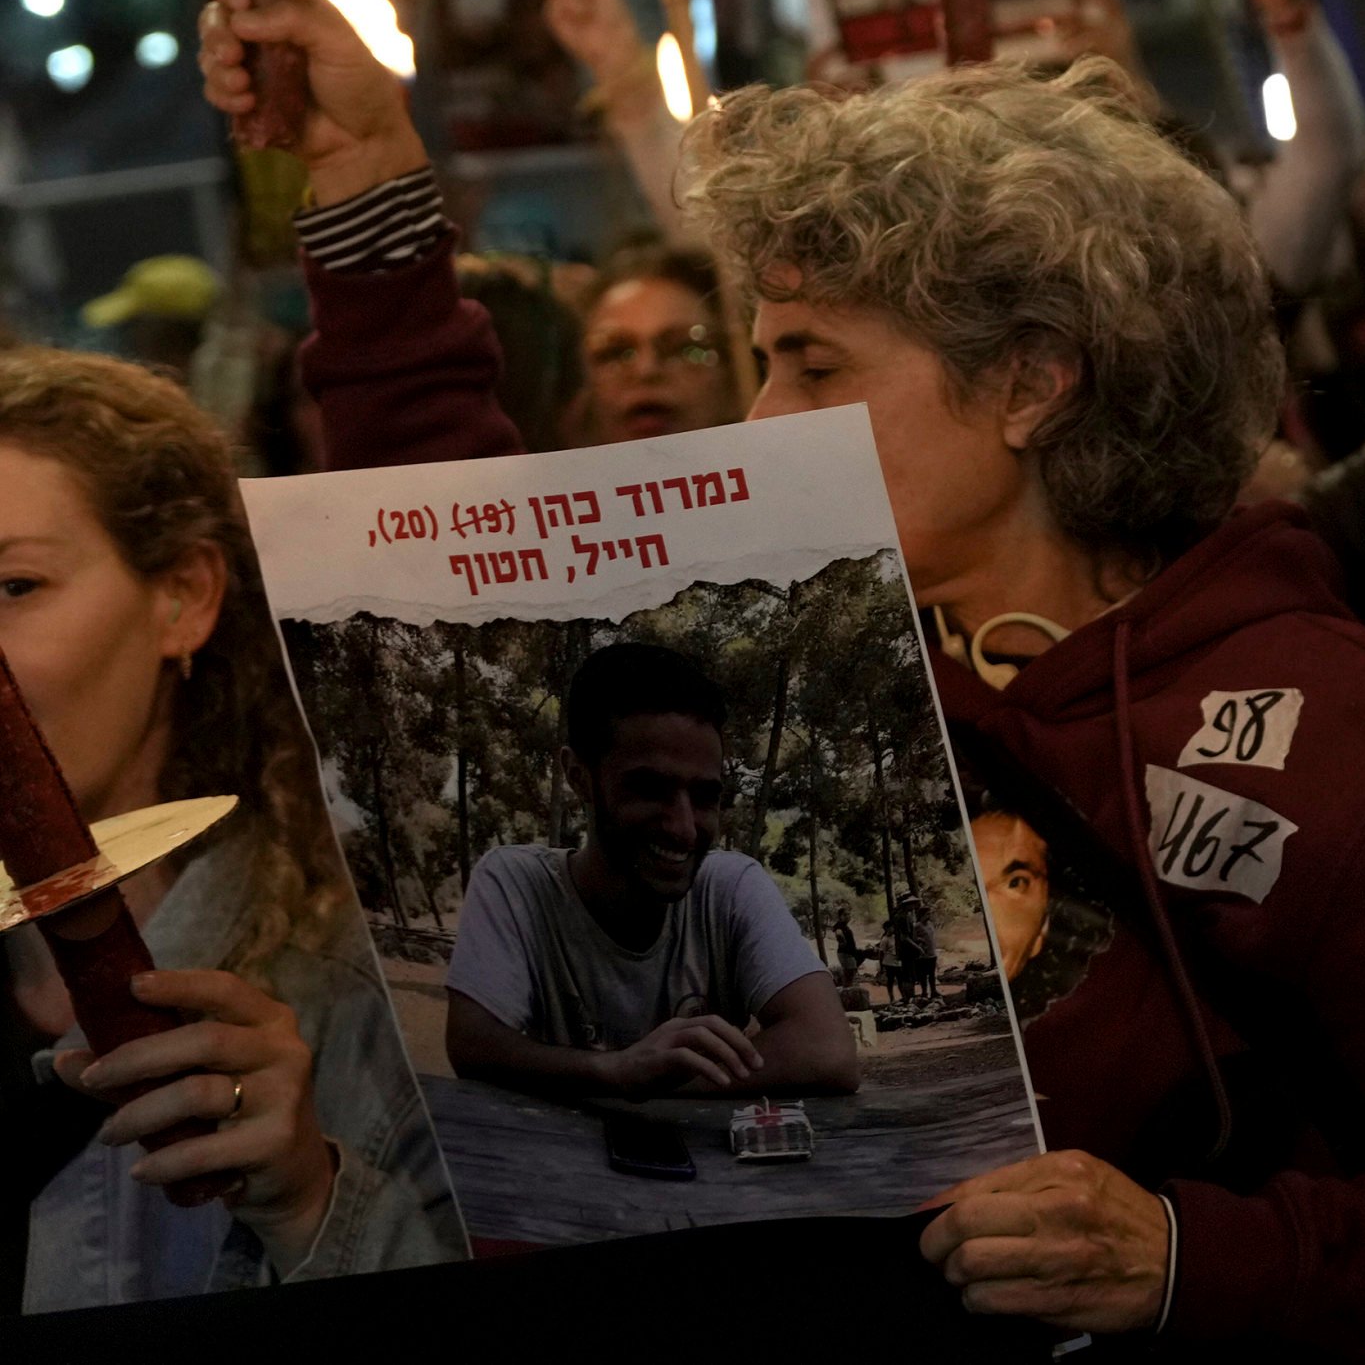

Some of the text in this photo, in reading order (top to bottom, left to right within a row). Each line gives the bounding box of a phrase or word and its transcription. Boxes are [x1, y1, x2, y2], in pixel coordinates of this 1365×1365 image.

[528, 490, 602, 539] כהן
[615, 467, 750, 517] נמרוד
[449, 533, 670, 596] חייל, חטוף
[1197, 690, 1285, 761] 98
[1158, 791, 1280, 882] 467
